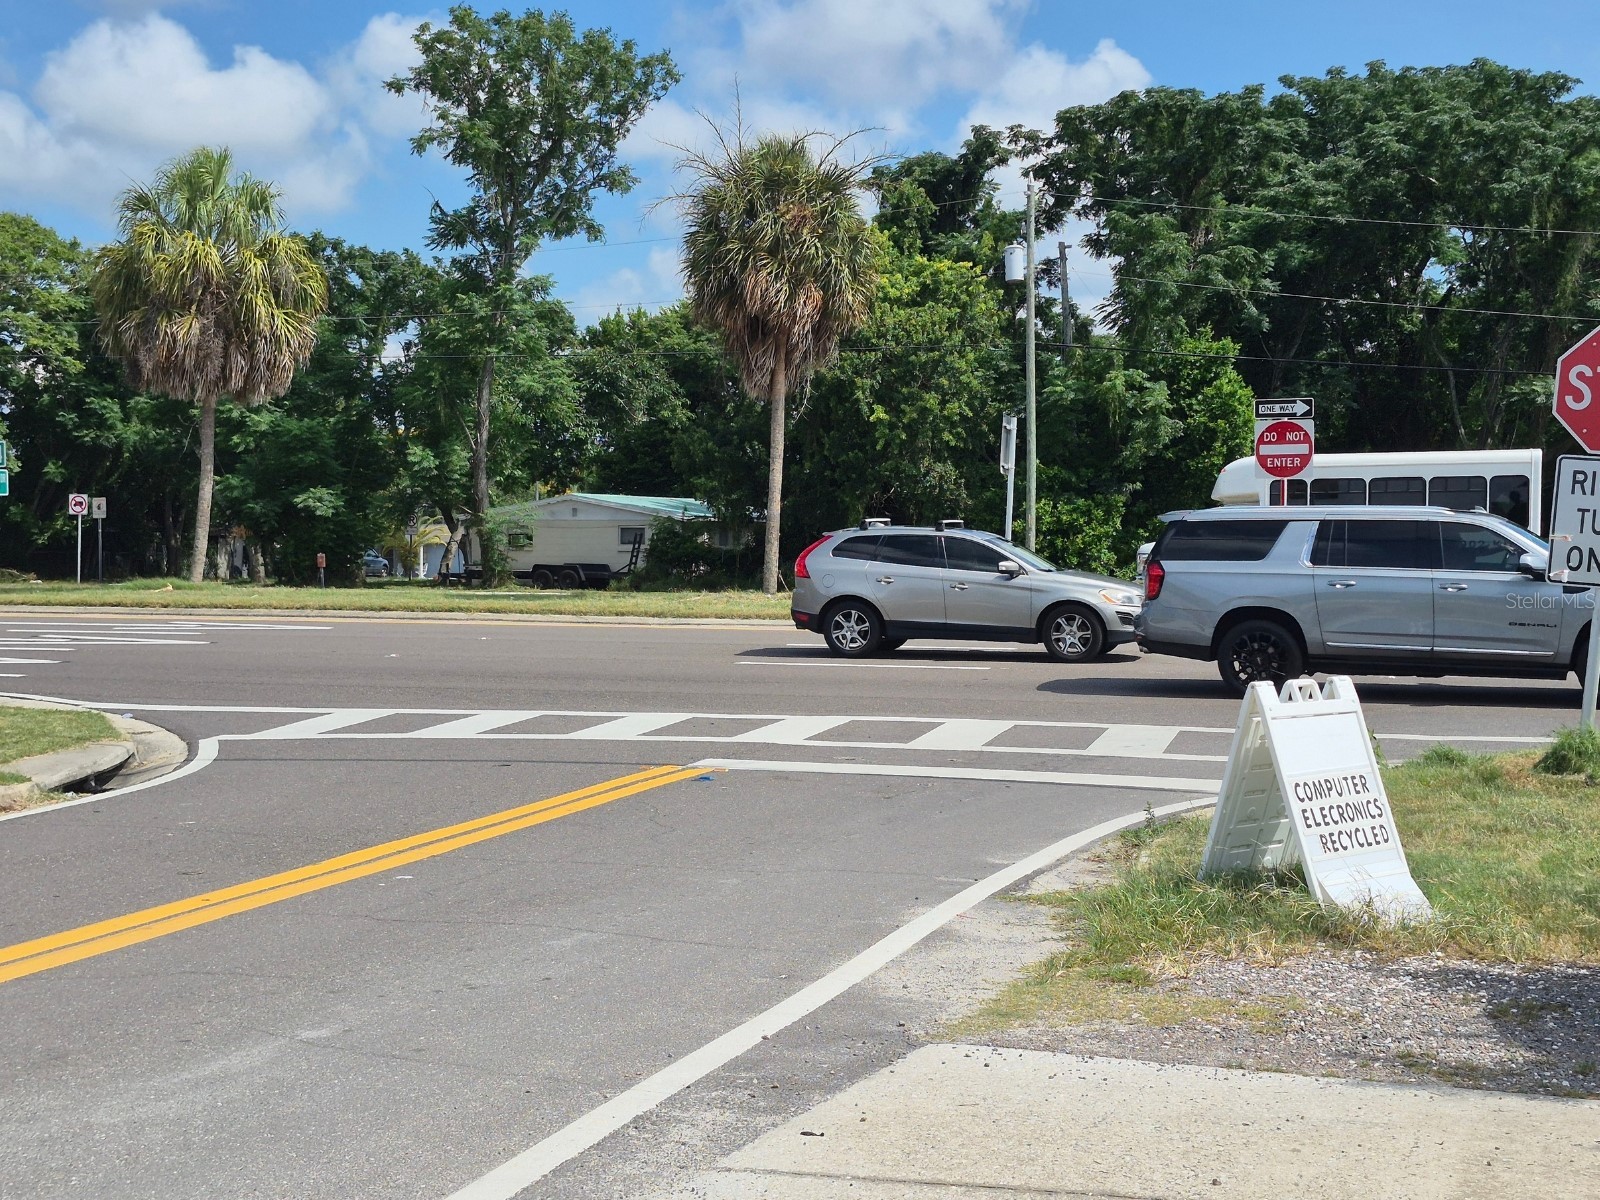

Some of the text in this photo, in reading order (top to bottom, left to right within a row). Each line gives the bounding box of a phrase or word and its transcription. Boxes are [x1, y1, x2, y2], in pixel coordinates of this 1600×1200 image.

[1565, 364, 1600, 411] S
[1260, 404, 1295, 413] ONE WAY
[1263, 431, 1305, 442] DO NOT
[1267, 457, 1301, 468] ENTER
[1571, 469, 1597, 496] RI
[1294, 774, 1370, 803] COMPUTER
[1301, 798, 1383, 829] ELECRONICS
[1319, 824, 1389, 854] RECYCLED
